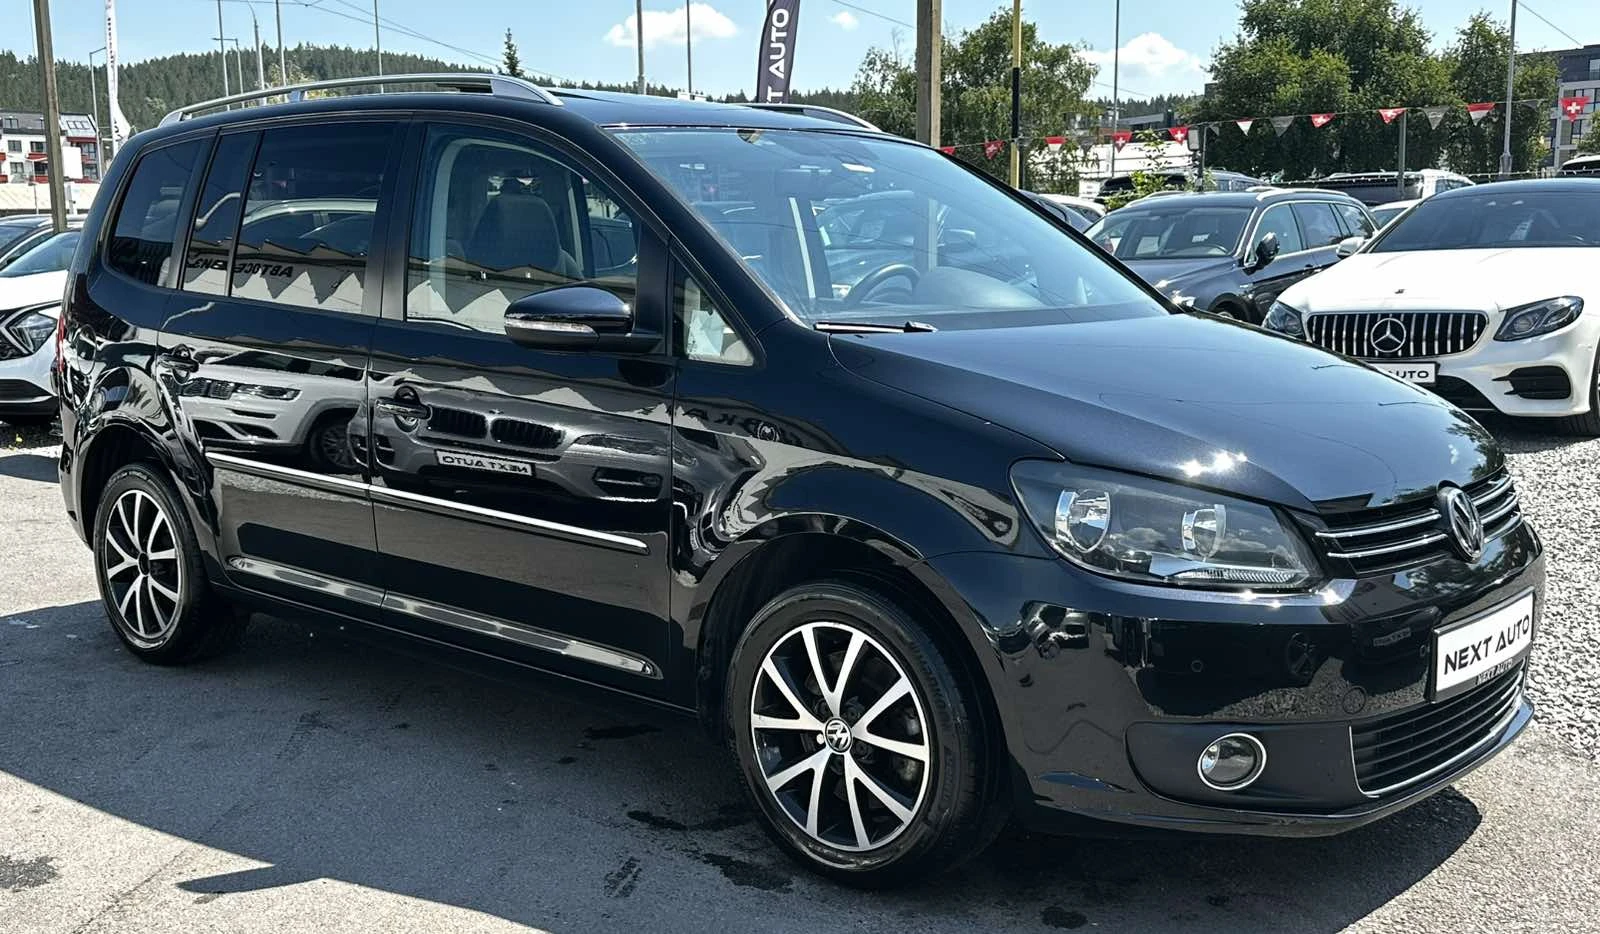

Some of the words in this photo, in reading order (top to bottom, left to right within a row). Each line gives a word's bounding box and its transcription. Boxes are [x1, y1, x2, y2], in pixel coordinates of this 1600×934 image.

[769, 8, 789, 79] AUTO
[1388, 370, 1429, 379] UTO
[1443, 636, 1493, 675] NEXT
[1495, 614, 1530, 653] AUTO
